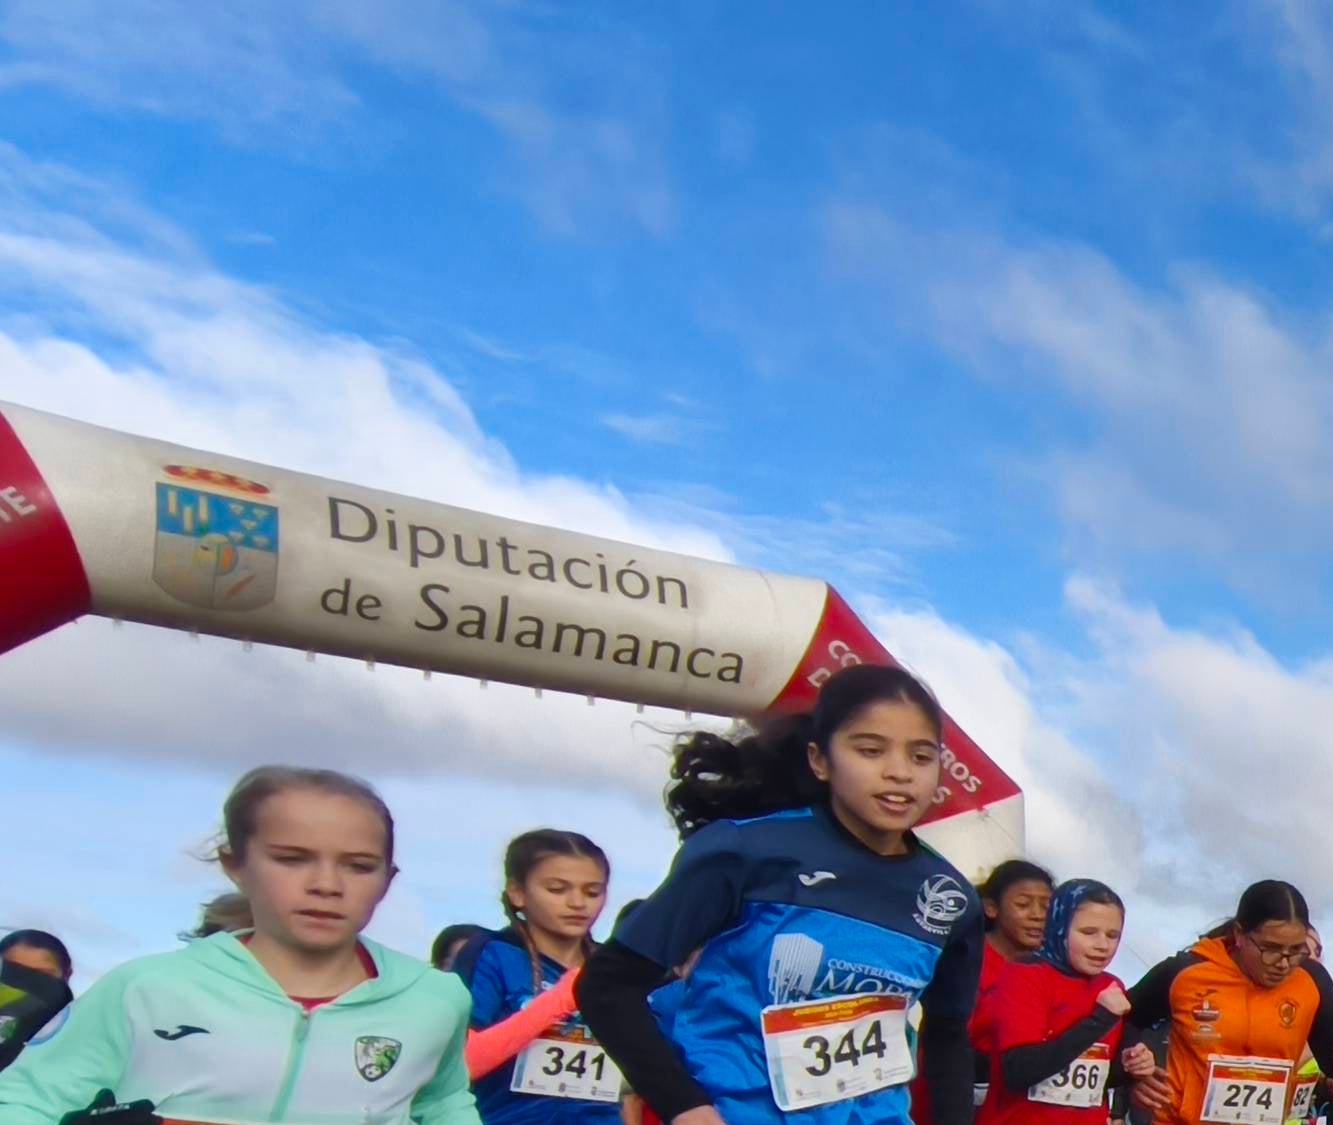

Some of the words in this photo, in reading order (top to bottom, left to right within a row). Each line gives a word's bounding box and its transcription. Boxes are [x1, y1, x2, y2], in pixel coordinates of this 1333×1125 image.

[327, 496, 689, 608] Diputación
[320, 577, 383, 621] de
[414, 582, 744, 684] Salamanca
[542, 1046, 605, 1081] 341
[803, 1020, 887, 1077] 344
[1052, 1064, 1100, 1090] 366
[1223, 1084, 1273, 1110] 274
